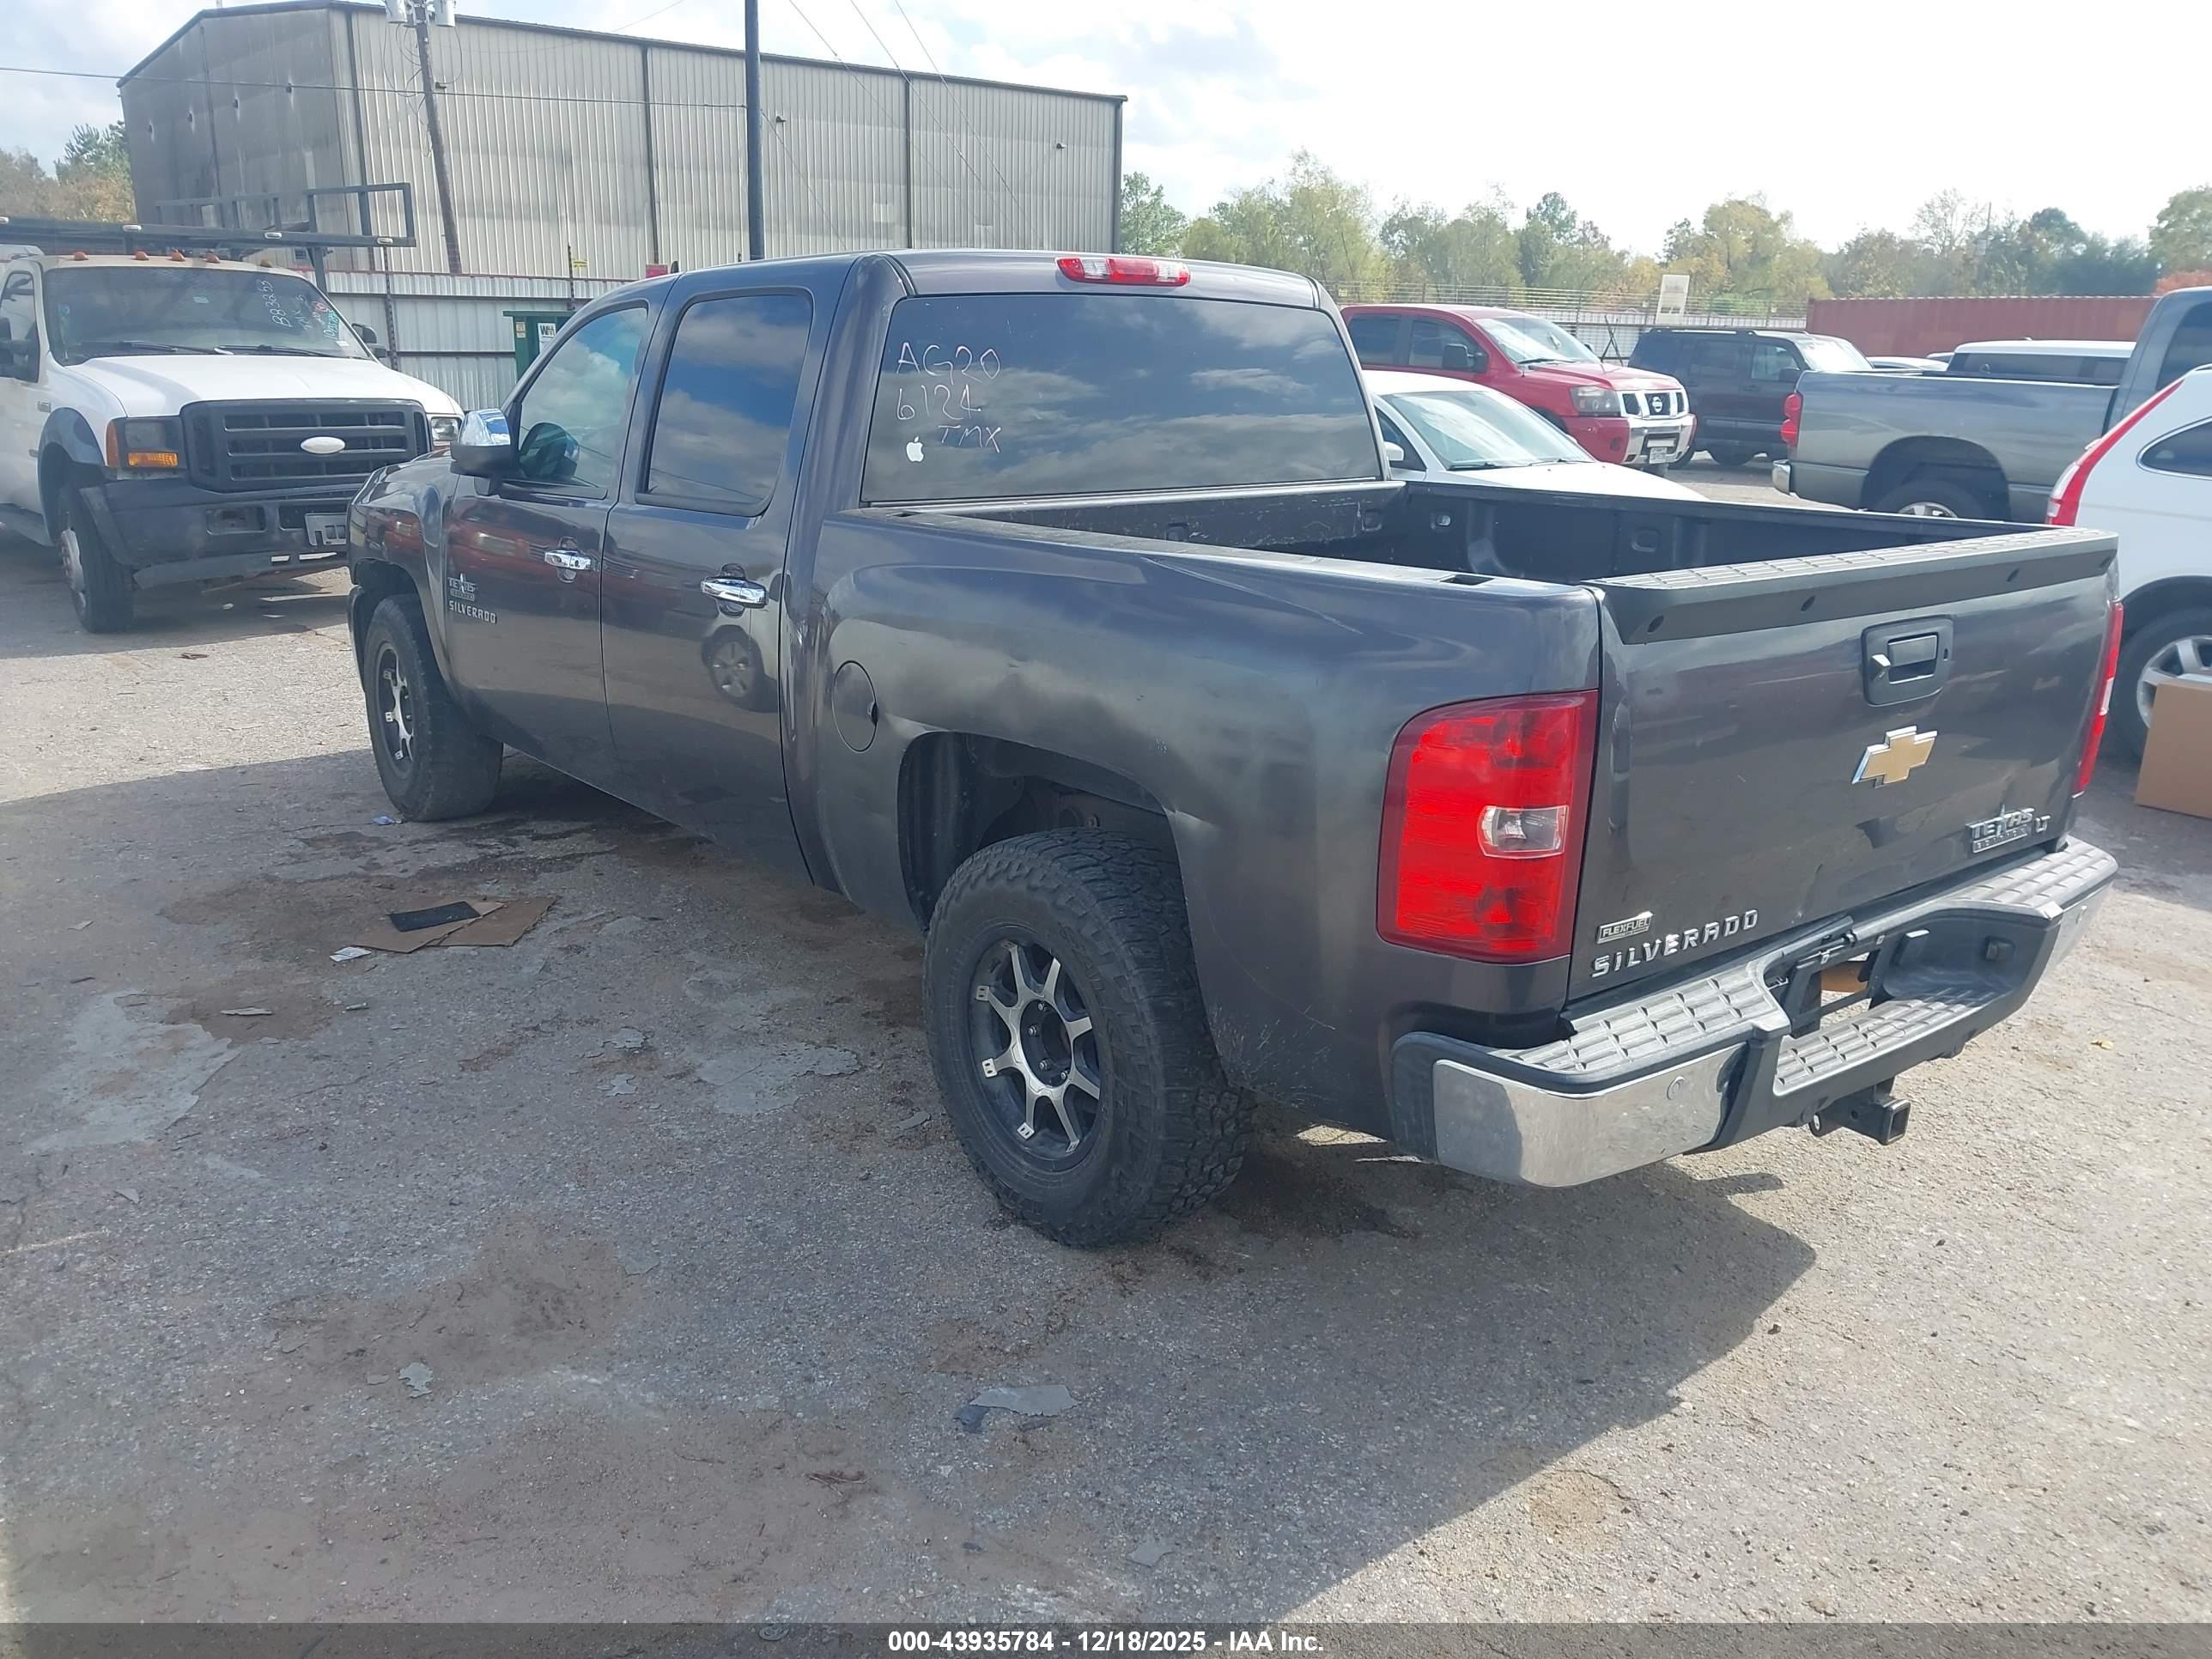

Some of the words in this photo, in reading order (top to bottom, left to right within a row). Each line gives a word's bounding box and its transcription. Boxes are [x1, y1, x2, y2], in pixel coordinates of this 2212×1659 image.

[896, 342, 1001, 386] AG20
[896, 384, 982, 421] 6124
[938, 424, 1002, 453] TMX
[449, 600, 496, 624] SILVERADO
[1591, 908, 1759, 979] SILVERADO
[1602, 918, 1650, 938] FLEXFUEL
